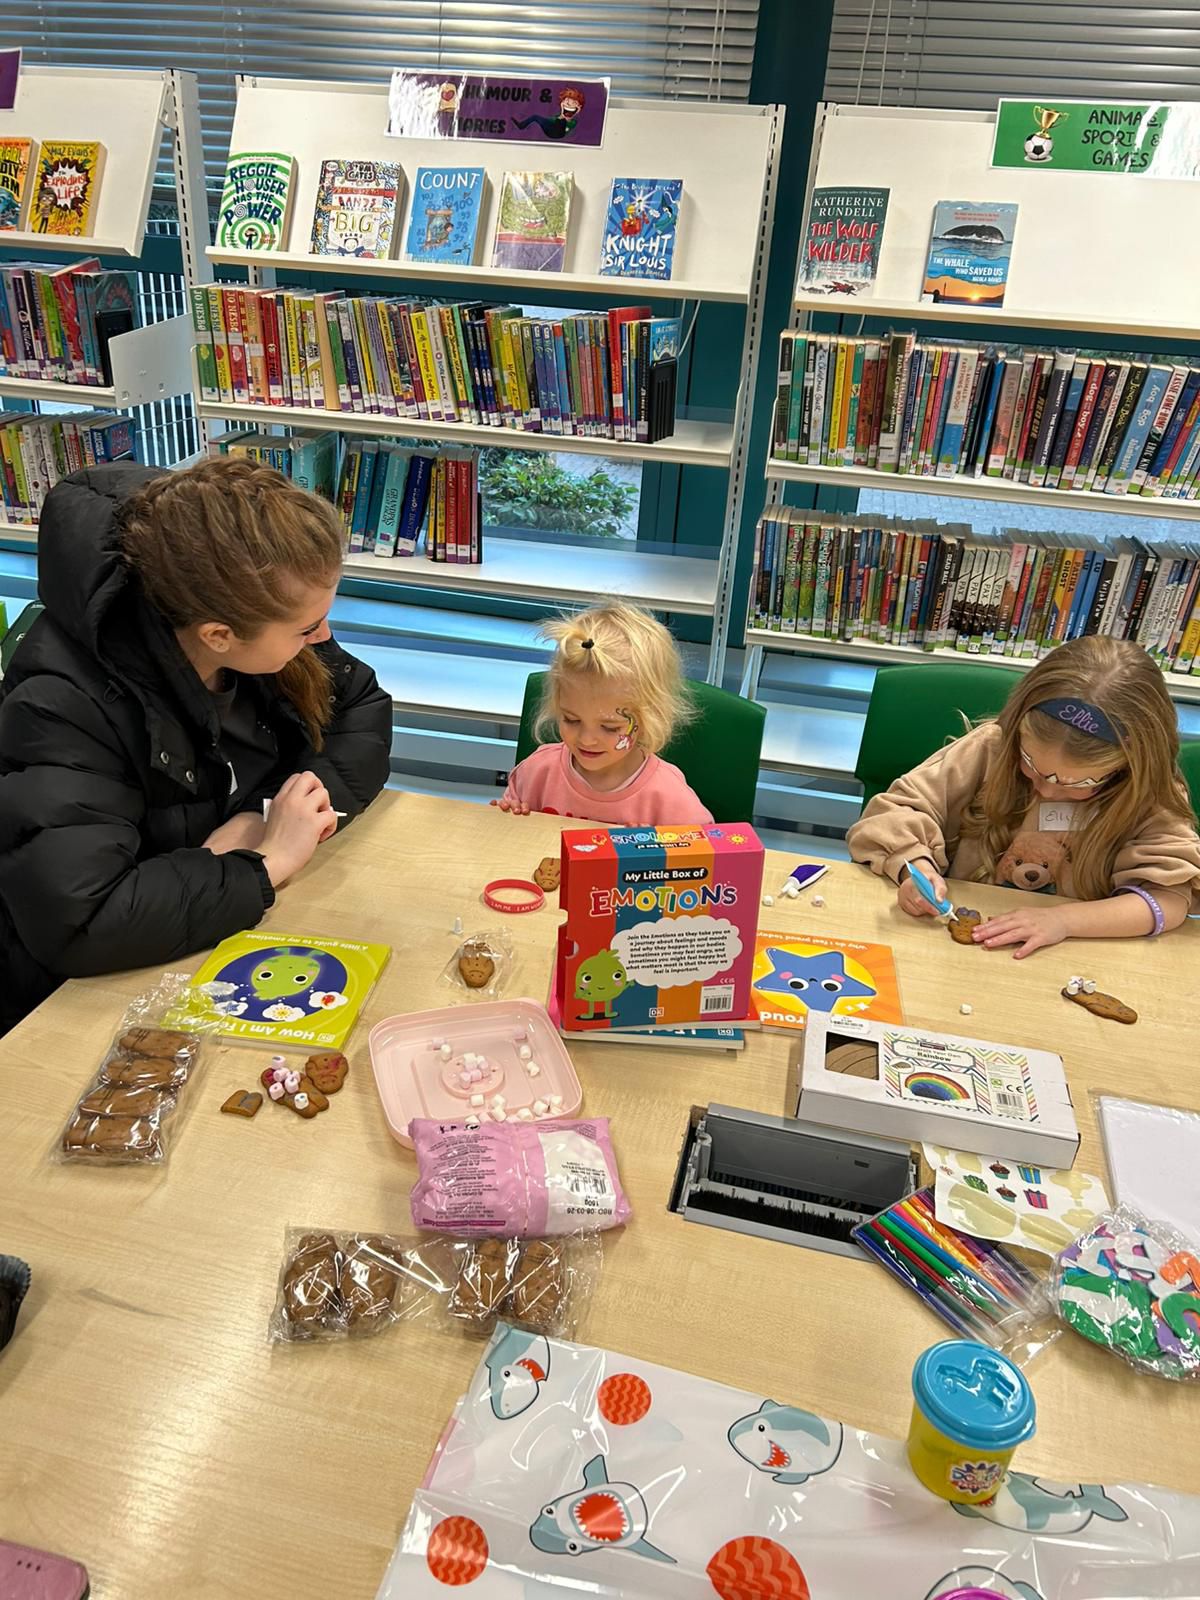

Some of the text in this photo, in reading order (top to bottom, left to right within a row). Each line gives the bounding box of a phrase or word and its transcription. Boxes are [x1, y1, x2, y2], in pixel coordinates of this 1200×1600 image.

[465, 86, 553, 102] HUMOUR &
[452, 119, 506, 134] IARIES
[1151, 135, 1160, 147] &
[1093, 150, 1148, 167] GAMES
[230, 163, 278, 182] REGGIE
[420, 171, 480, 189] COUNT
[233, 192, 274, 205] HAS THE
[454, 197, 474, 212] 100
[814, 197, 884, 207] KATHERINE
[224, 202, 282, 226] POWER
[819, 208, 875, 217] RUNDELL
[335, 212, 374, 233] BIG
[811, 219, 879, 239] THE WOLF
[606, 234, 672, 256] KNIGHT
[808, 239, 873, 263] WILDER
[605, 254, 666, 270] SIR LOUIS
[944, 258, 970, 268] WHALE
[968, 267, 993, 276] SAVED
[993, 268, 1004, 276] US
[210, 292, 217, 302] JO
[227, 291, 235, 302] JO
[194, 290, 205, 330] JO NESBØ
[1169, 372, 1184, 395] LASSIE
[1077, 382, 1097, 429] dog boy
[1137, 384, 1161, 427] dog boy
[1042, 426, 1054, 455] MIDNIGHT
[1144, 441, 1156, 457] ERIC
[384, 488, 399, 526] GRANDPA'S
[940, 553, 953, 585] DEAD BALL
[1082, 558, 1090, 570] LU
[1093, 561, 1101, 573] LU
[1060, 560, 1072, 588] GHOST
[1067, 560, 1081, 593] PATINA
[956, 581, 966, 599] PAX
[969, 582, 979, 597] PAX
[981, 582, 991, 598] PAX
[993, 584, 1003, 599] PAX
[935, 590, 944, 609] TOM
[1094, 579, 1111, 618] Varjak Paw
[1058, 704, 1099, 735] Ellie
[610, 831, 707, 844] EMOTIONS
[625, 868, 705, 882] My Little Box of
[590, 883, 738, 917] EMOTIONS
[760, 1011, 804, 1024] roud
[239, 1024, 315, 1040] How Am I
[917, 1051, 952, 1062] Rainbow
